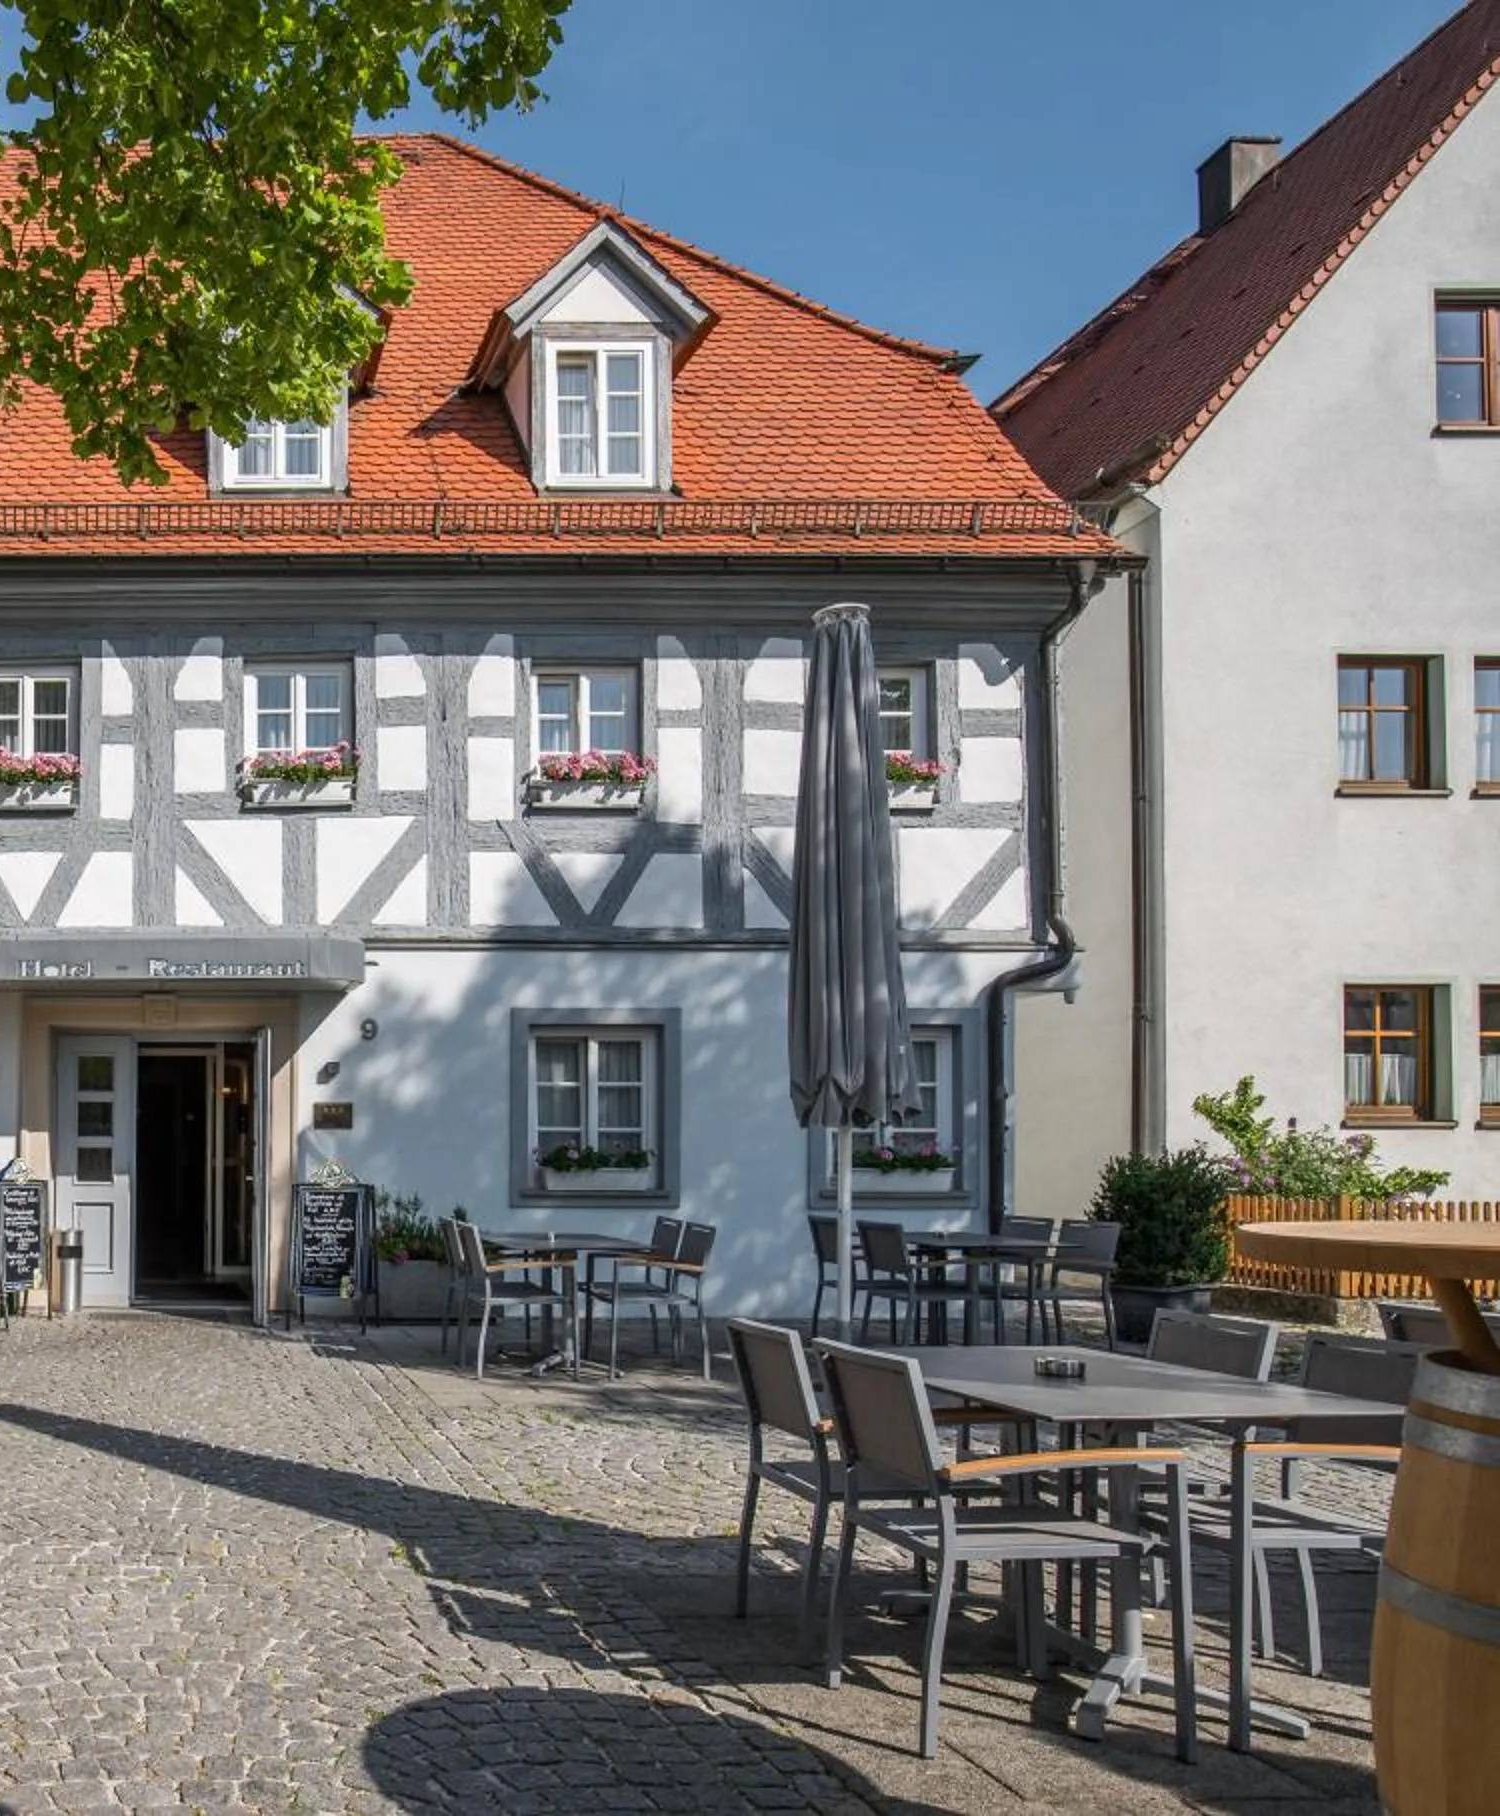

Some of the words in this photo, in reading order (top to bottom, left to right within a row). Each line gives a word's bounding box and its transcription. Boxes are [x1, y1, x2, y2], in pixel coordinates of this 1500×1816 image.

[20, 959, 92, 977] Hotel
[148, 959, 307, 977] Restaurant
[360, 1018, 378, 1041] 9
